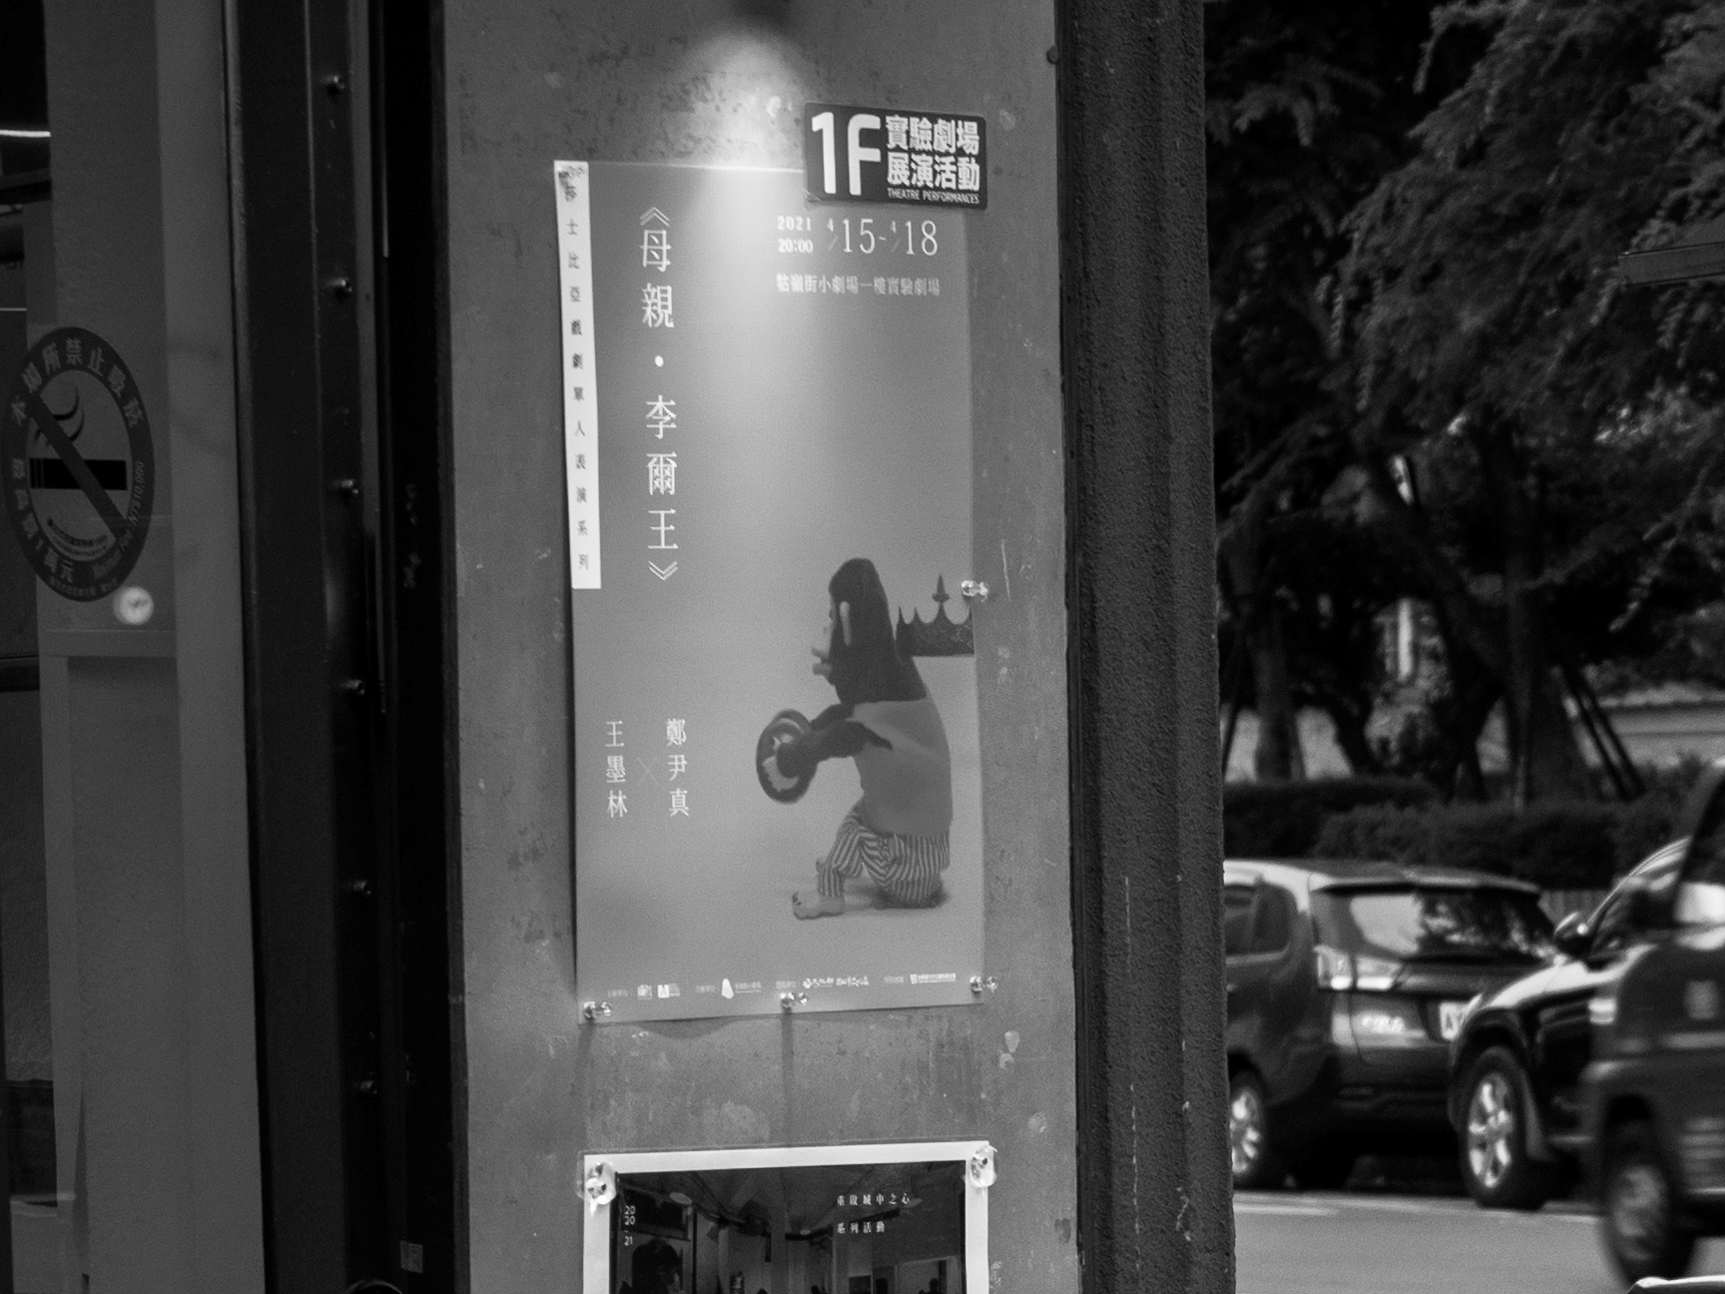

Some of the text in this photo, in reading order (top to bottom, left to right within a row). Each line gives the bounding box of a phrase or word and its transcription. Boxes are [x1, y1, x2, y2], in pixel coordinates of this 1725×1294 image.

[811, 111, 881, 196] 1F
[885, 114, 980, 155] 實驗劇場
[886, 151, 981, 192] 展演活動
[776, 215, 812, 231] 2021
[778, 238, 813, 253] 20:00
[605, 720, 628, 818] 王墨林
